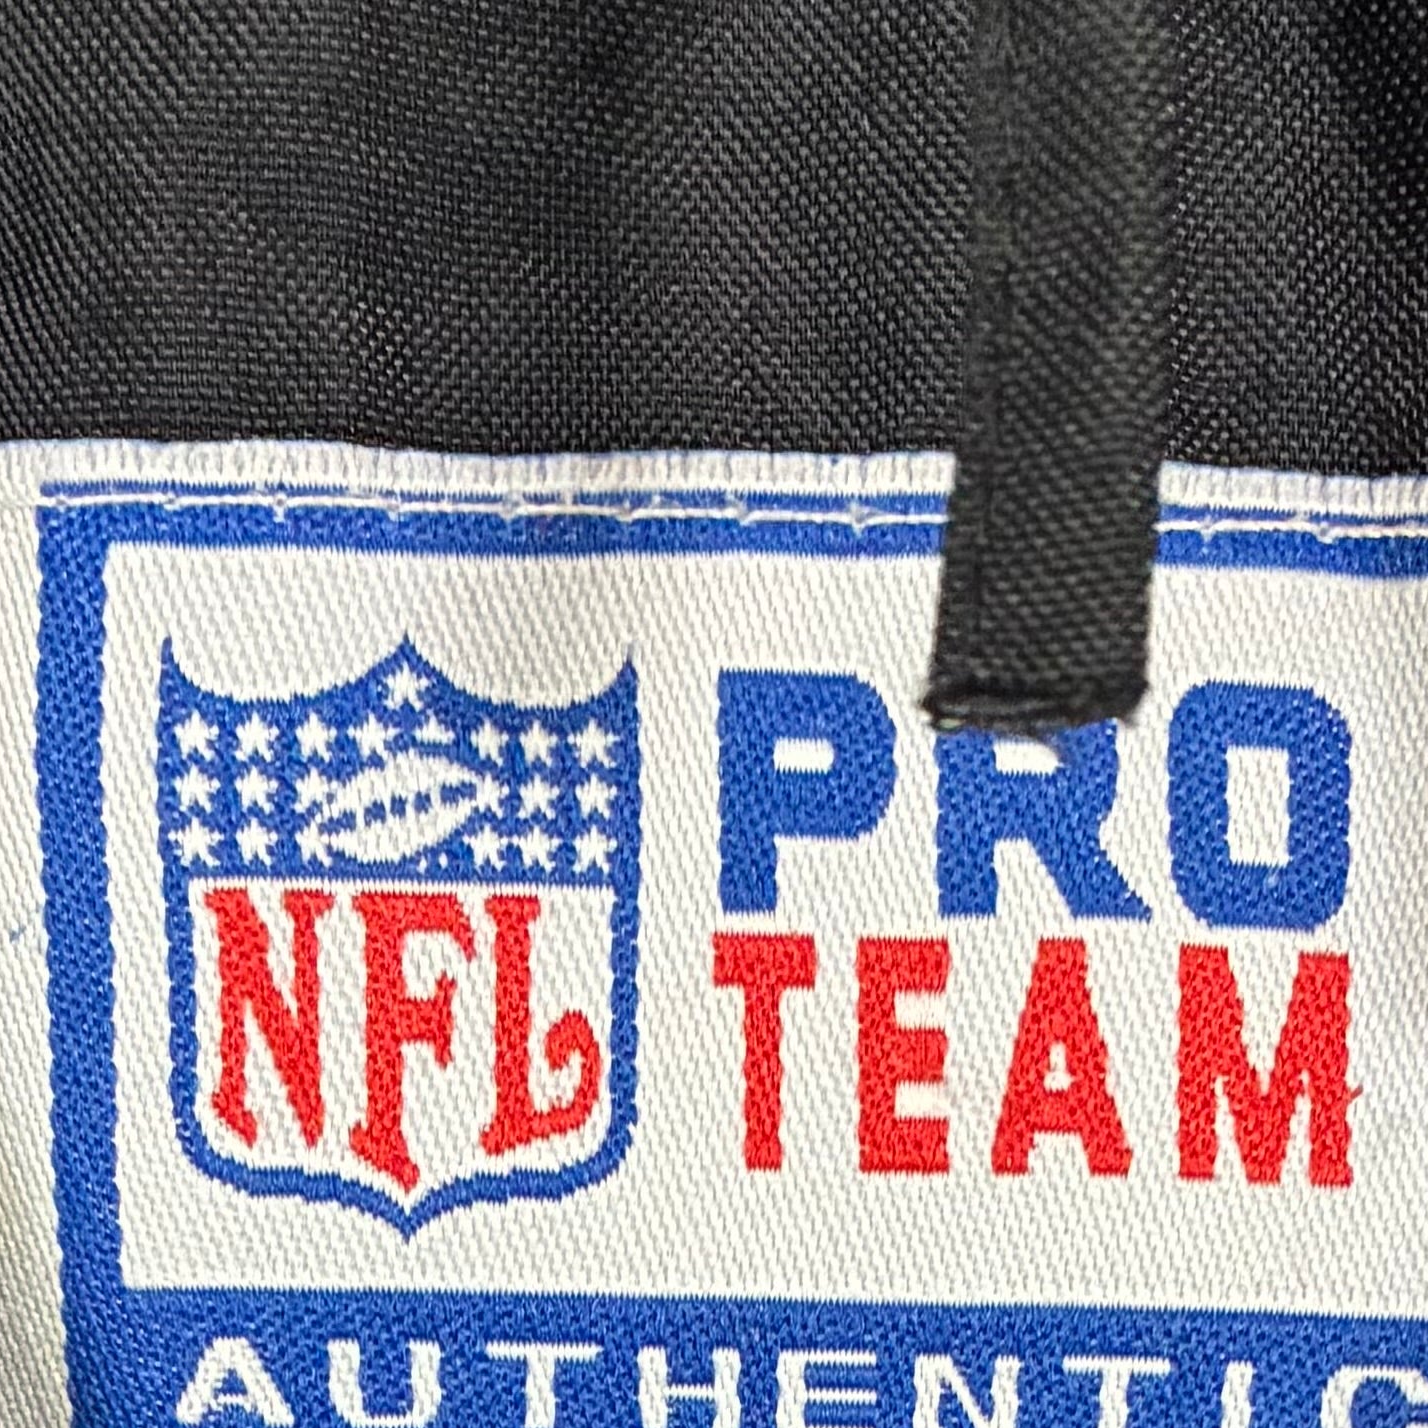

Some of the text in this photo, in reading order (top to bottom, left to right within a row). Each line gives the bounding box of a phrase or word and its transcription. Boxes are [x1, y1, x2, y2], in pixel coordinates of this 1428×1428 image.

[716, 668, 1353, 932] PRO
[203, 886, 605, 1194] NFL
[712, 932, 1355, 1188] TEAM
